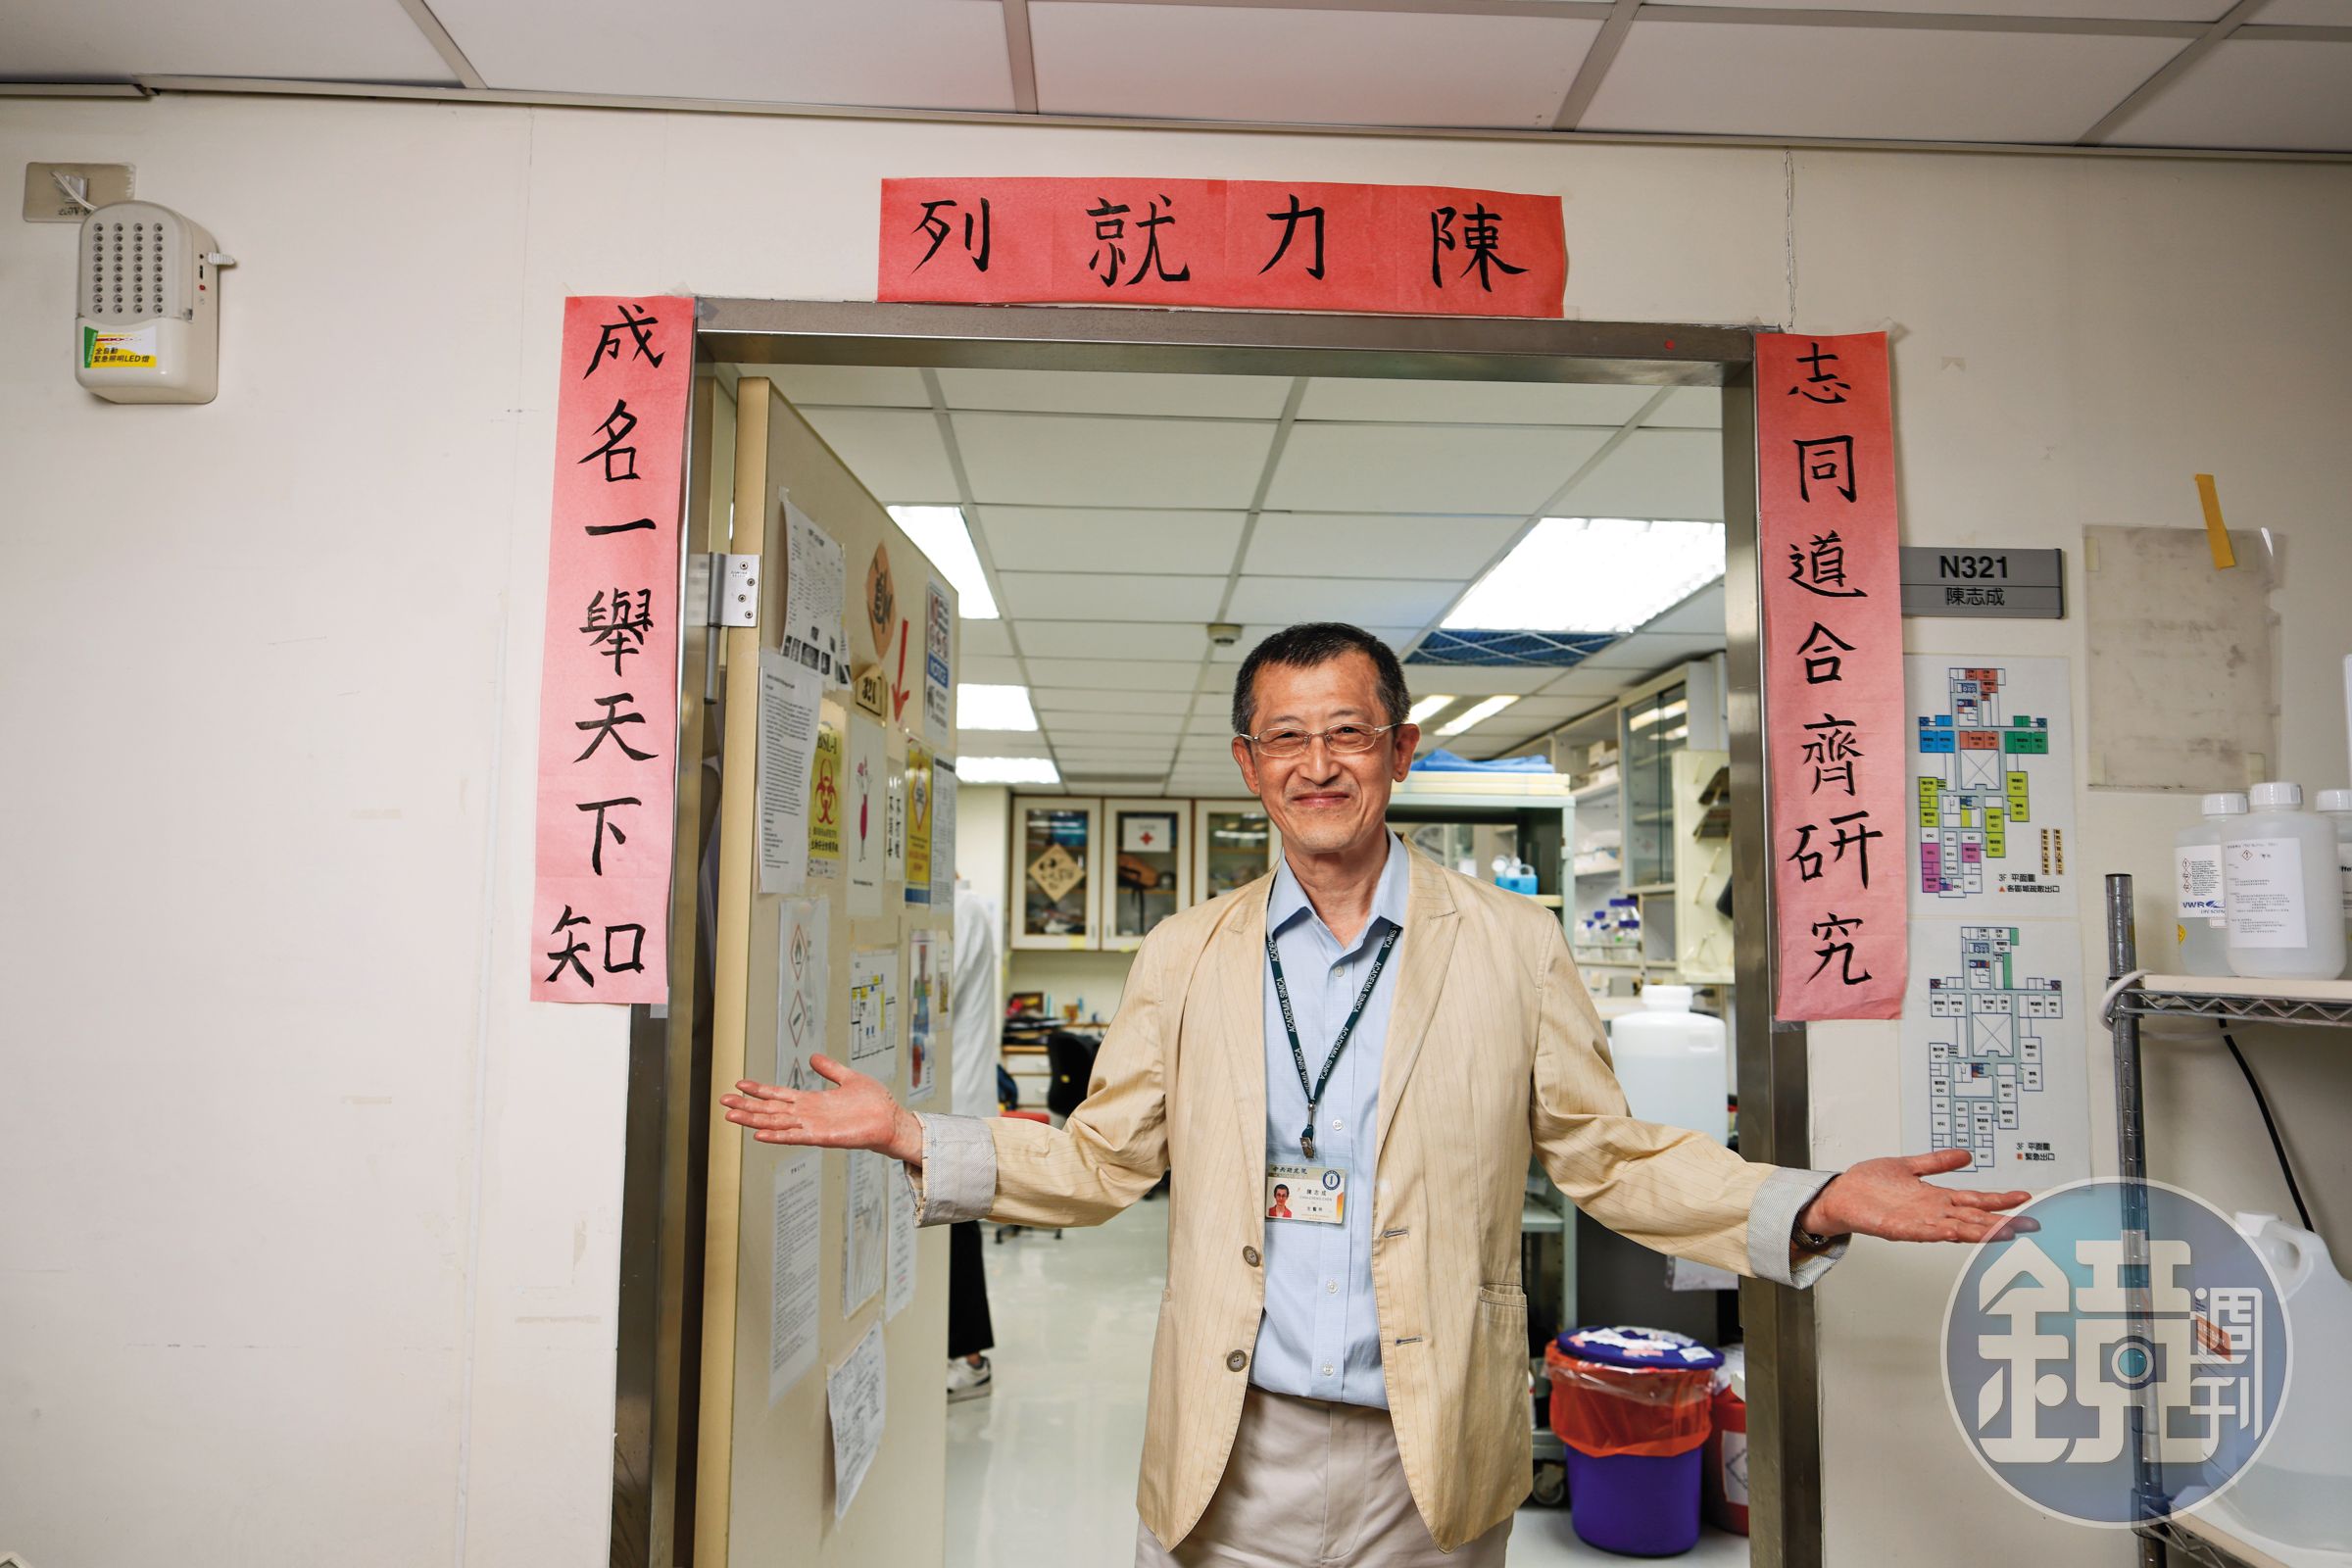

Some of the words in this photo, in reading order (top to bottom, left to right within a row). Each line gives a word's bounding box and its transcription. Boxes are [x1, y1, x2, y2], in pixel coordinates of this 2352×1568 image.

[1939, 555, 2008, 579] N321
[1945, 587, 2005, 606] 陳志成
[544, 304, 666, 988] 成名一舉天下知
[1787, 342, 1884, 986] 志同道合齊研究
[1276, 976, 1289, 999] SINICA
[1362, 960, 1383, 992] ACADEMIA
[1281, 999, 1296, 1033] ACADEMIA
[1352, 993, 1367, 1013] SINICA
[1329, 1026, 1349, 1058] ACADEMIA
[1319, 1058, 1333, 1080] SINICA
